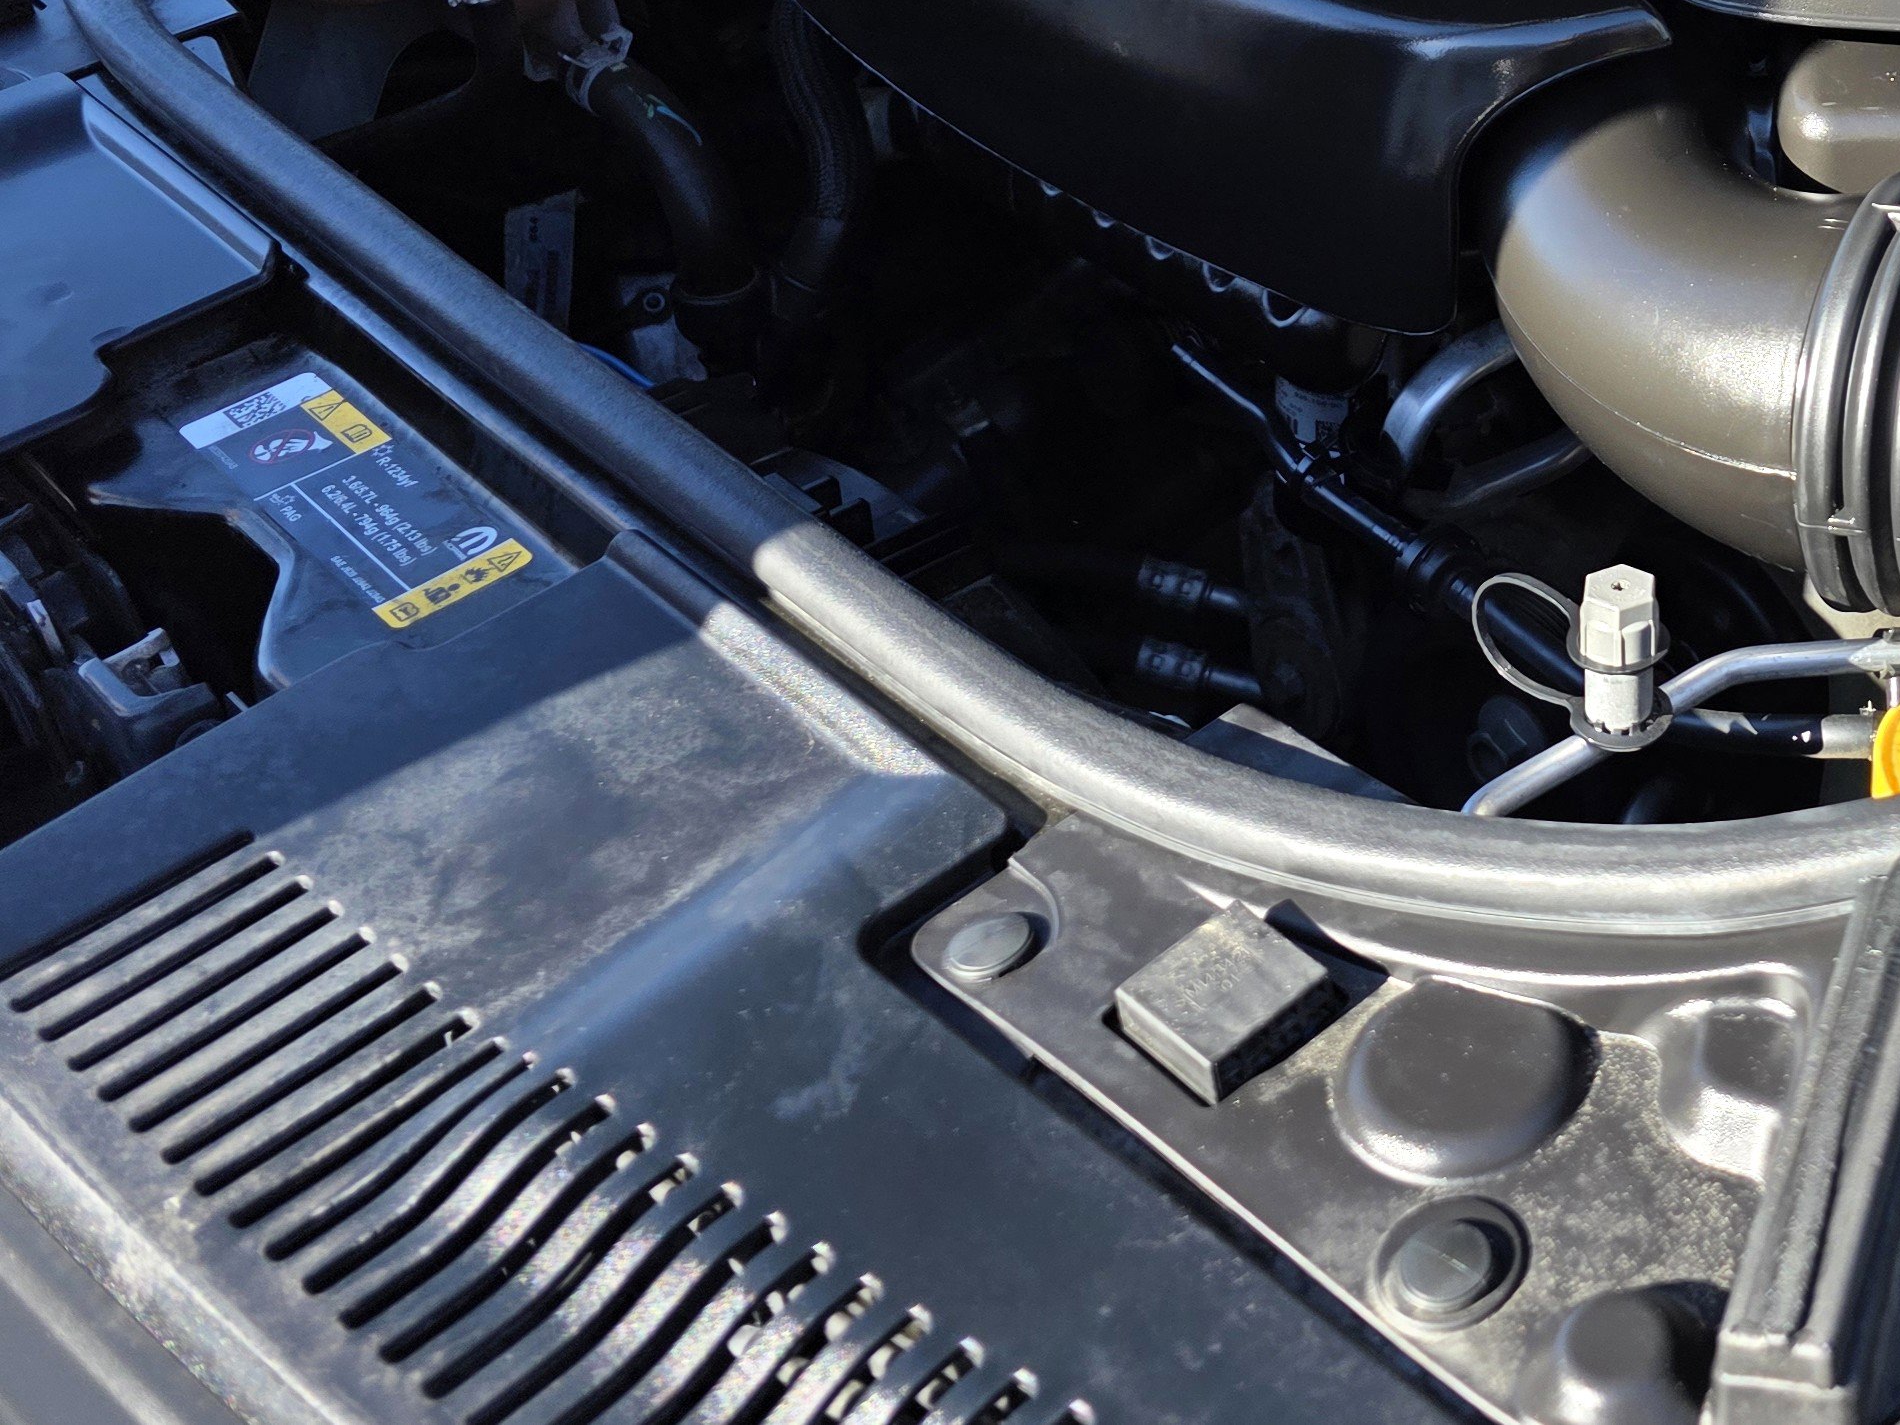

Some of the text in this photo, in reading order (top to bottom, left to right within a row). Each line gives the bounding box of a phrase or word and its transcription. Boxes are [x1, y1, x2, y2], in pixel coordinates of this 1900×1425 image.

[375, 456, 419, 488] R-1234yf
[280, 505, 302, 522] PAG
[375, 504, 402, 526] 964g
[413, 537, 438, 556] lbs)
[354, 513, 380, 536] 794g
[392, 547, 418, 567] lbs)
